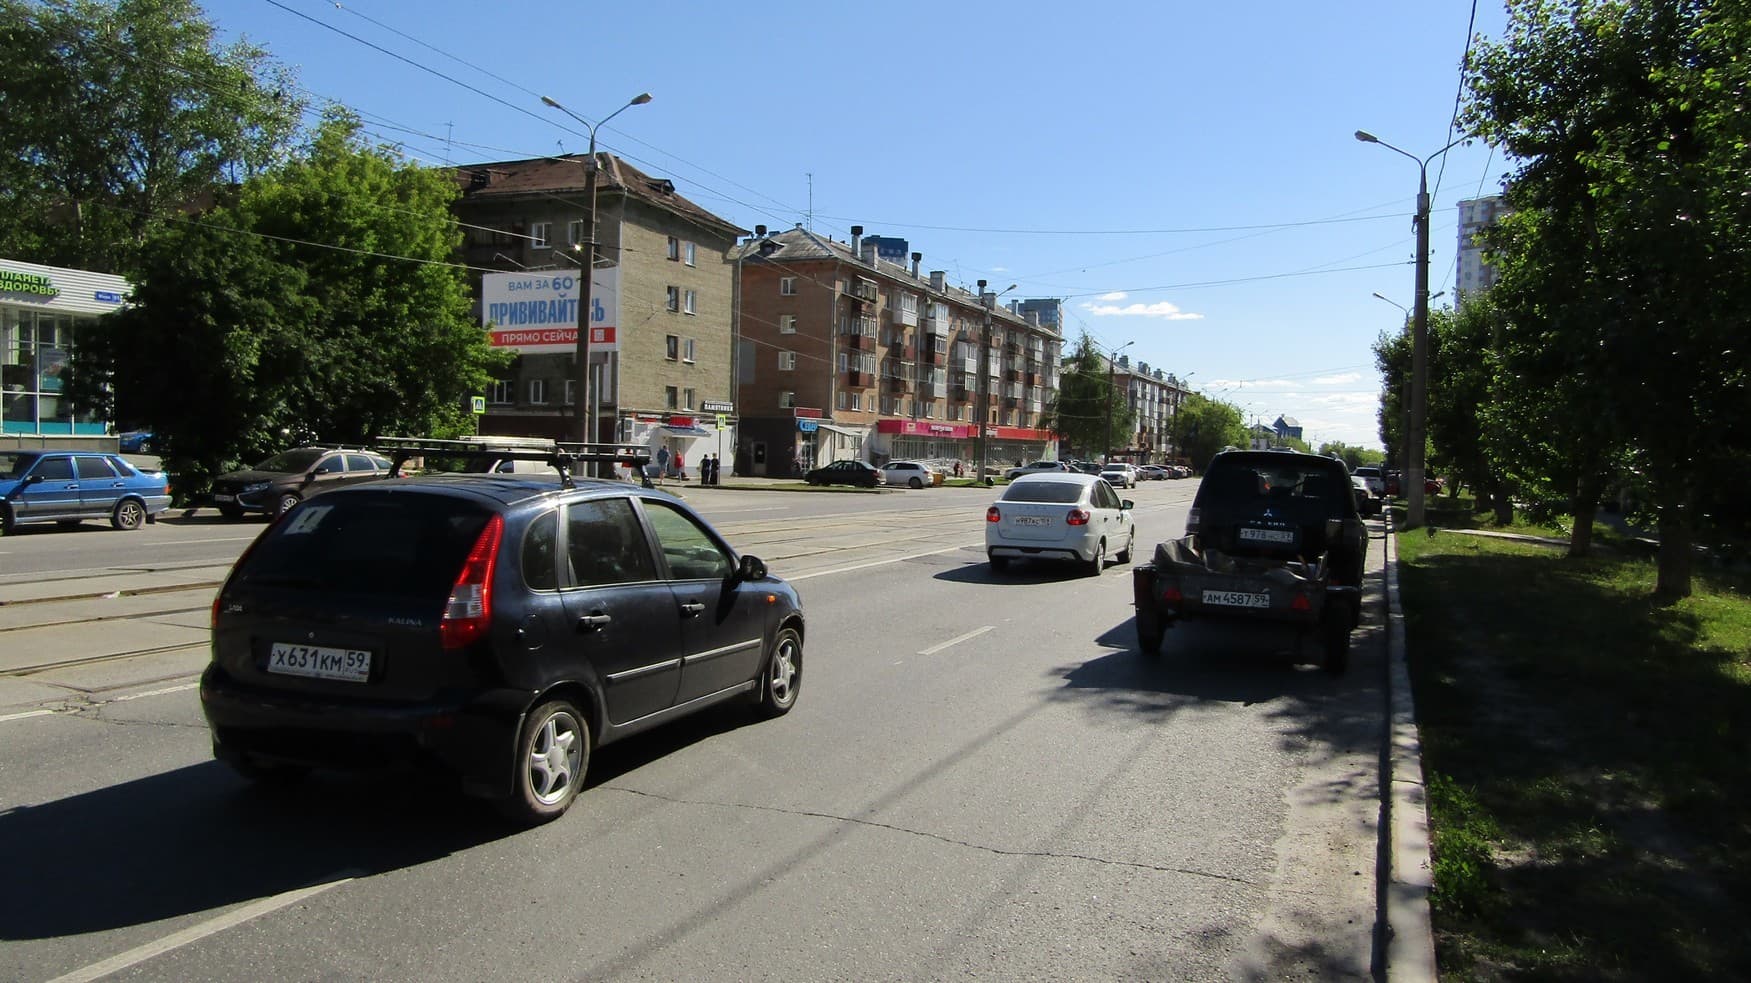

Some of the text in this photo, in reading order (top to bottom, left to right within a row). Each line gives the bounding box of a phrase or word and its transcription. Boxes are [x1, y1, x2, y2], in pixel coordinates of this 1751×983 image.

[508, 277, 573, 291] ВАМ ЗА 60
[489, 293, 604, 326] ПРИВИВАЙТЬ
[501, 330, 578, 344] ПРЯМО СЕЙЧА
[1206, 592, 1266, 605] АМ 4587 59
[275, 647, 365, 672] Х631КМ 59
